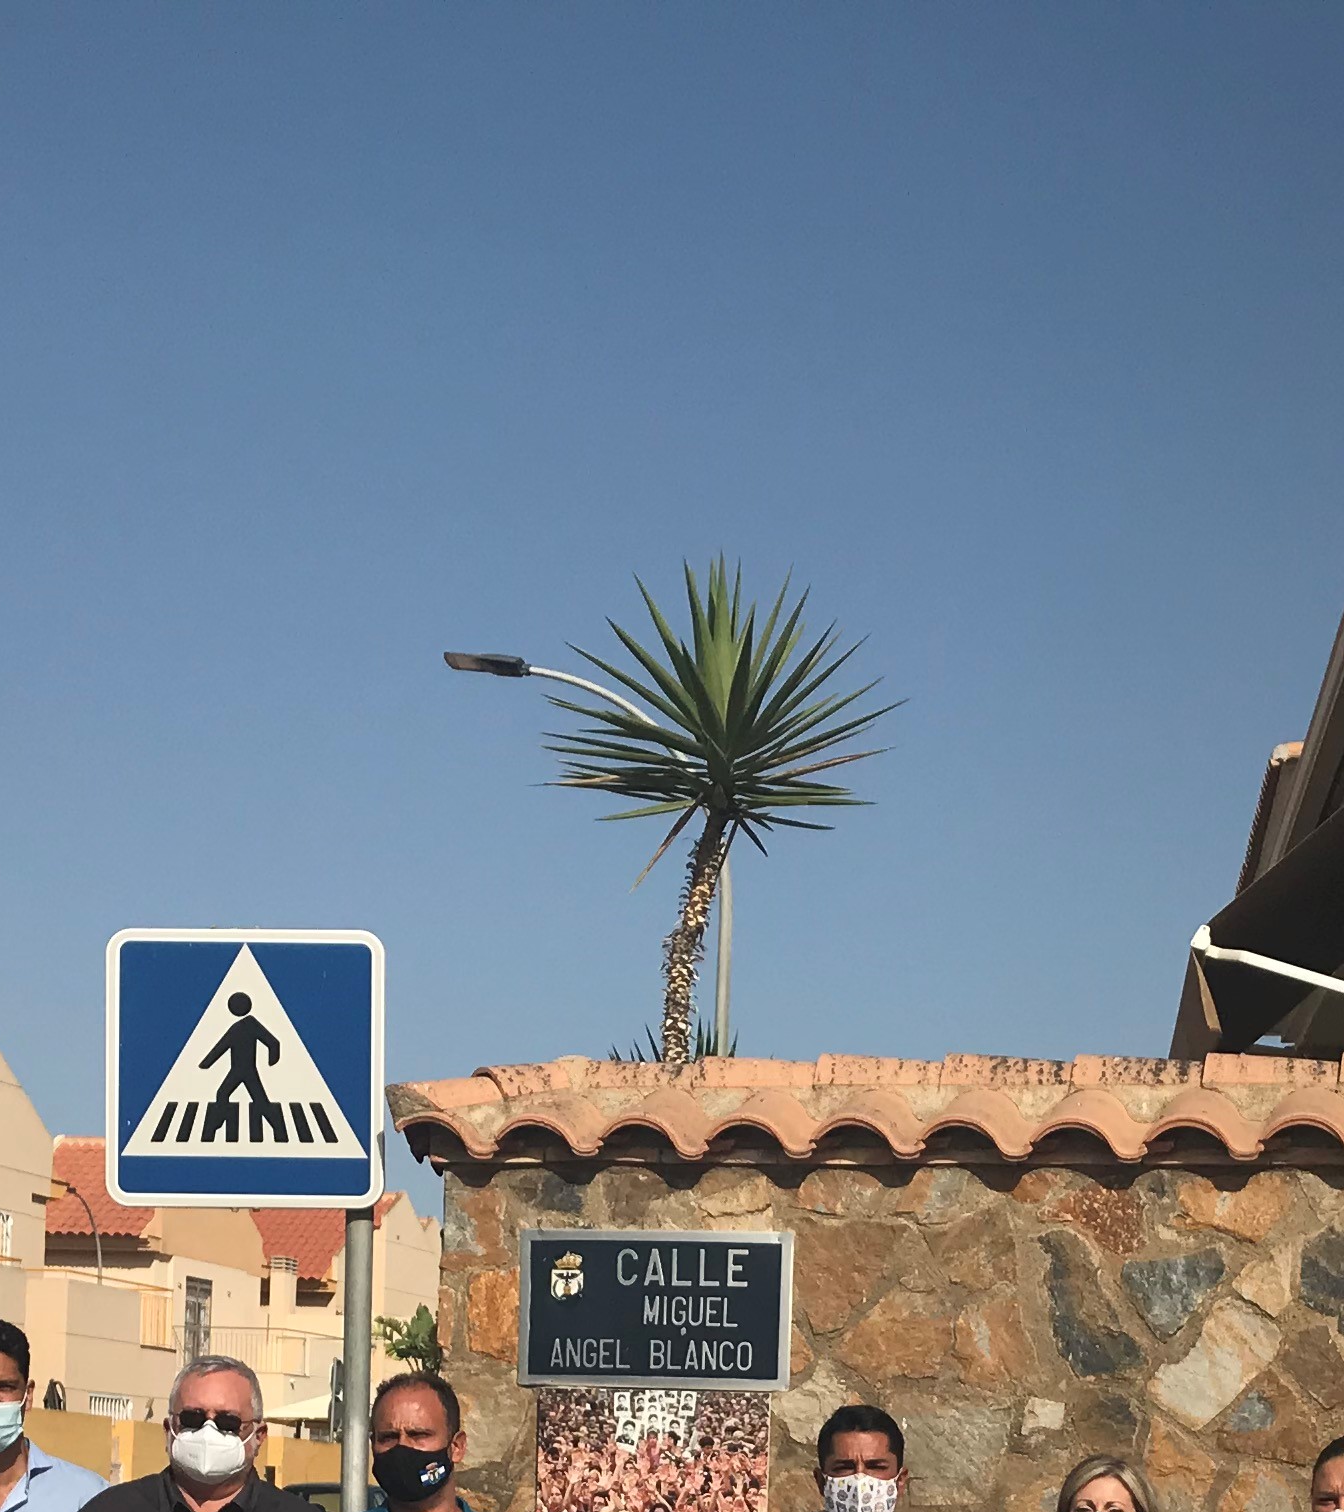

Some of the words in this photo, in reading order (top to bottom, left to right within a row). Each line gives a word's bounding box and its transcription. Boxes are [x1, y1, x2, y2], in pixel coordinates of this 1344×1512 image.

[616, 1248, 749, 1288] CALLE
[642, 1295, 738, 1328] MIGUEL
[550, 1338, 631, 1369] ANGEL
[649, 1340, 753, 1371] BLANCO
